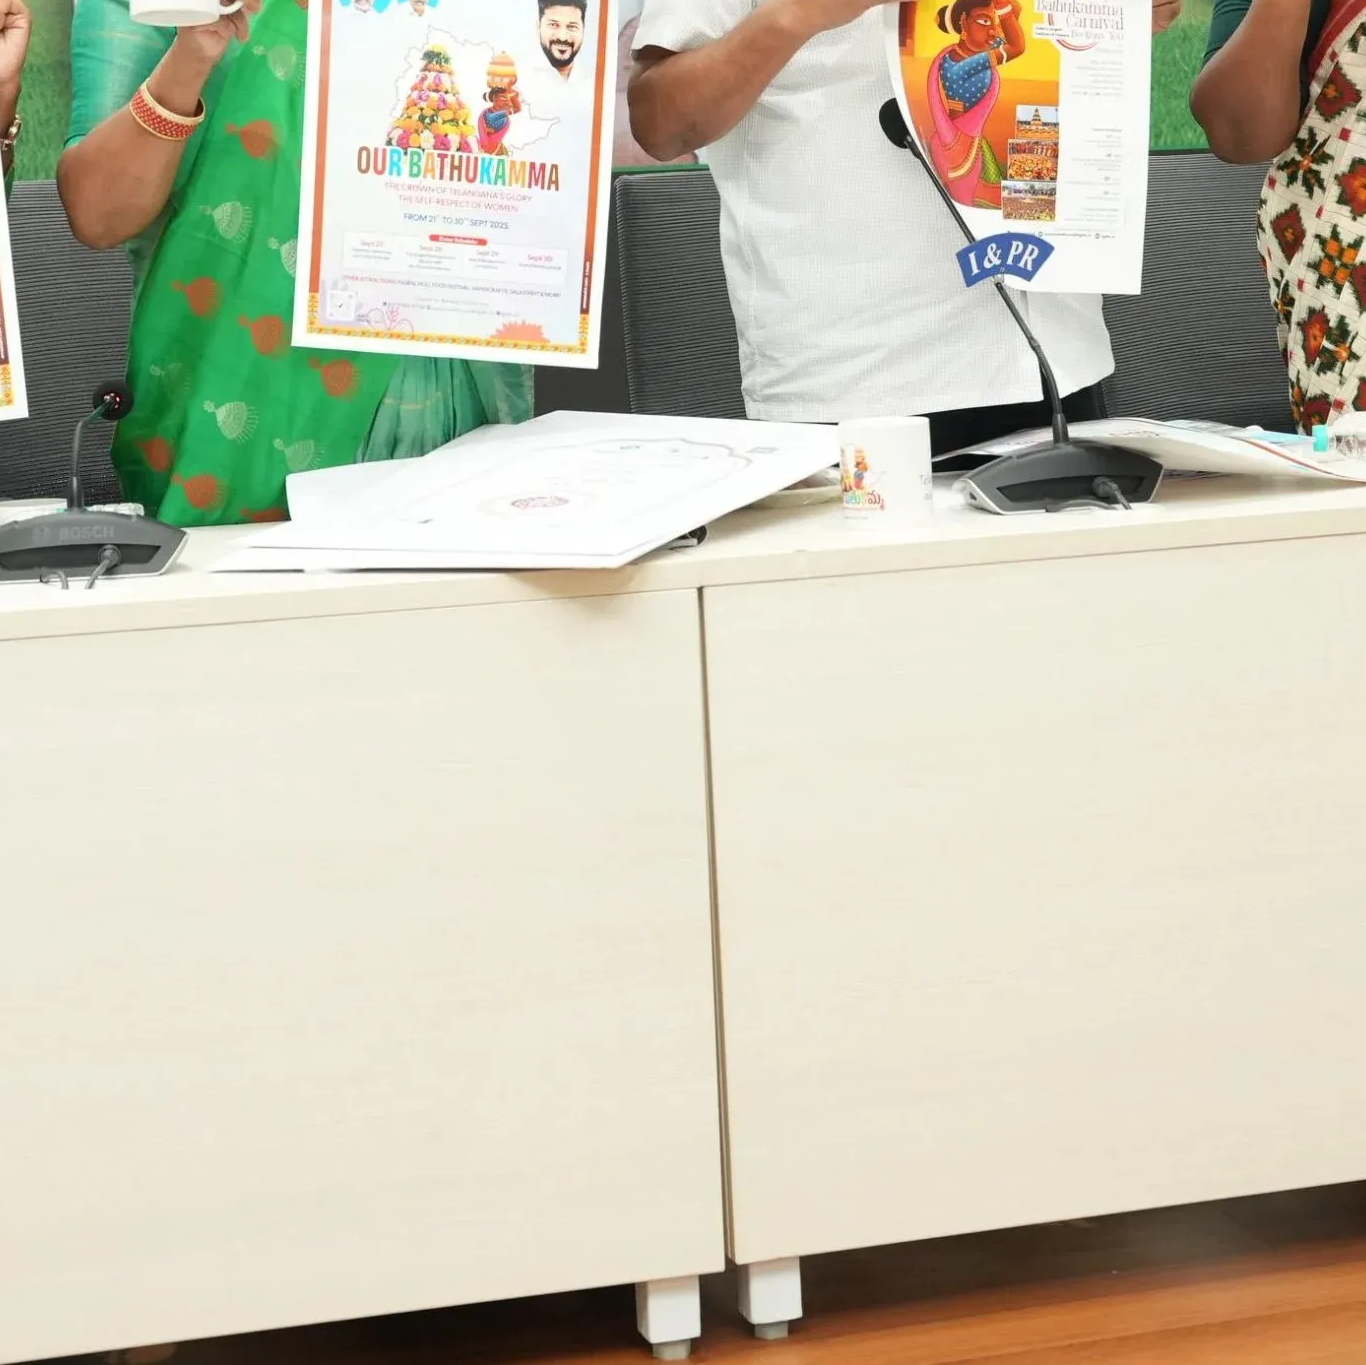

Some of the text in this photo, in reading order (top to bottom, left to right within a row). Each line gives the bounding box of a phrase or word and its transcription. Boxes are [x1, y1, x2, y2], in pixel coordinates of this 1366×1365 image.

[1066, 14, 1123, 30] Carnival
[357, 145, 560, 191] OUR BATHUKAMMA
[506, 193, 532, 202] GLORY
[484, 202, 519, 212] WOMEN
[403, 212, 427, 222] FROM
[441, 216, 454, 225] TO
[470, 218, 488, 227] SEPT
[968, 241, 1039, 276] I & PR
[59, 524, 115, 542] BOSCH
